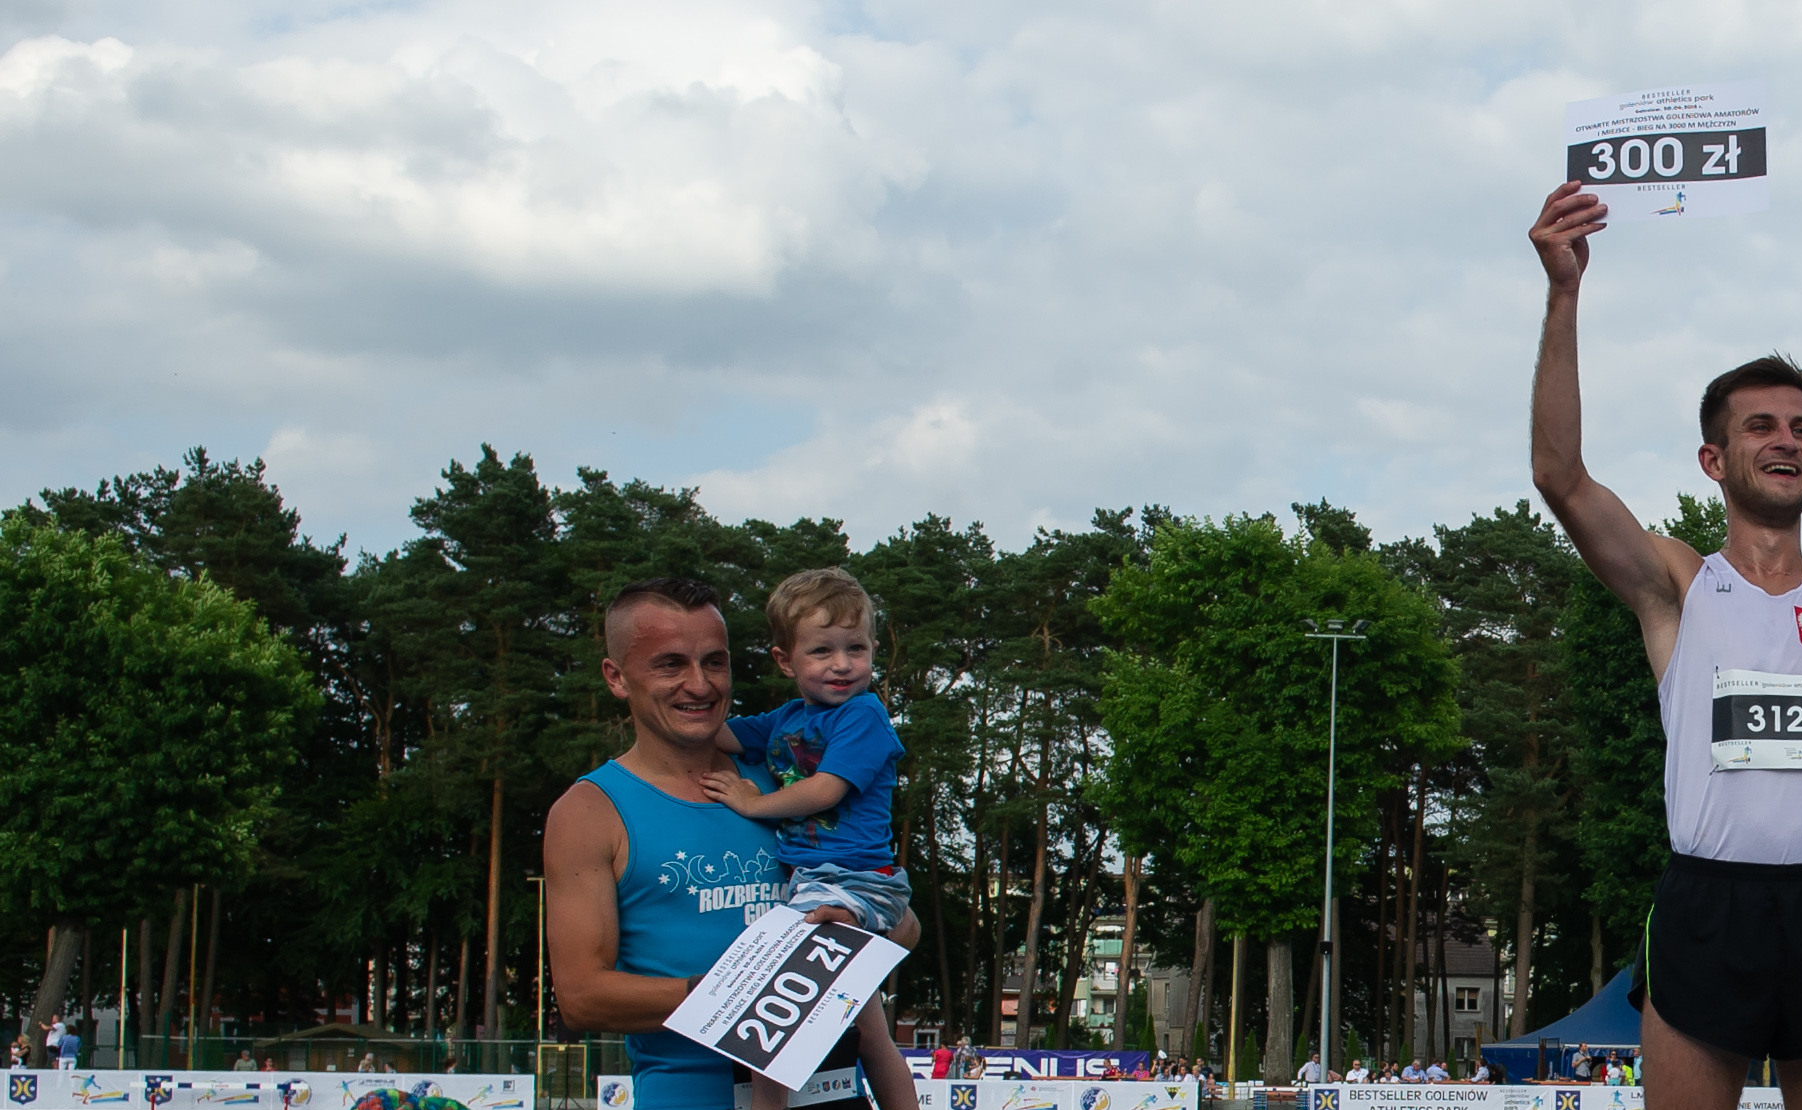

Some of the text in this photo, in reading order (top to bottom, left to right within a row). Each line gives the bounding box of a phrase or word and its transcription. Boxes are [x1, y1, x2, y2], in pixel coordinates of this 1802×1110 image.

[1641, 89, 1691, 99] BESTSELLER
[1656, 96, 1692, 104] athletics
[1694, 94, 1714, 102] park
[1575, 108, 1760, 132] OTWARTE MISTRZOSTWA GOLENIOWA AMATORÓW
[1602, 127, 1630, 136] MIEJSCE
[1697, 120, 1736, 128] MĘŻCZYZN
[1588, 134, 1742, 180] 300 zł
[1637, 184, 1687, 192] BESTSELLER
[1716, 681, 1759, 690] BESTSELLER
[714, 941, 746, 977] BESTSELLER
[731, 944, 755, 970] athletics
[753, 930, 767, 945] park
[725, 998, 747, 1021] MIEJSCE
[747, 982, 761, 996] BIEG
[758, 973, 768, 983] NA
[765, 959, 779, 973] 3000
[775, 953, 783, 961] M
[781, 928, 807, 954] MĘŻCZYZN
[700, 1010, 722, 1035] OTWARTE
[722, 971, 756, 1010] MISTRZOSTWA
[754, 939, 783, 971] GOLENIOWA
[737, 934, 853, 1053] 200 zł
[808, 988, 837, 1024] BESTSELLER
[906, 1057, 1119, 1079] RENUS
[1349, 1089, 1488, 1101] BESTSELLER GOLENIÓW
